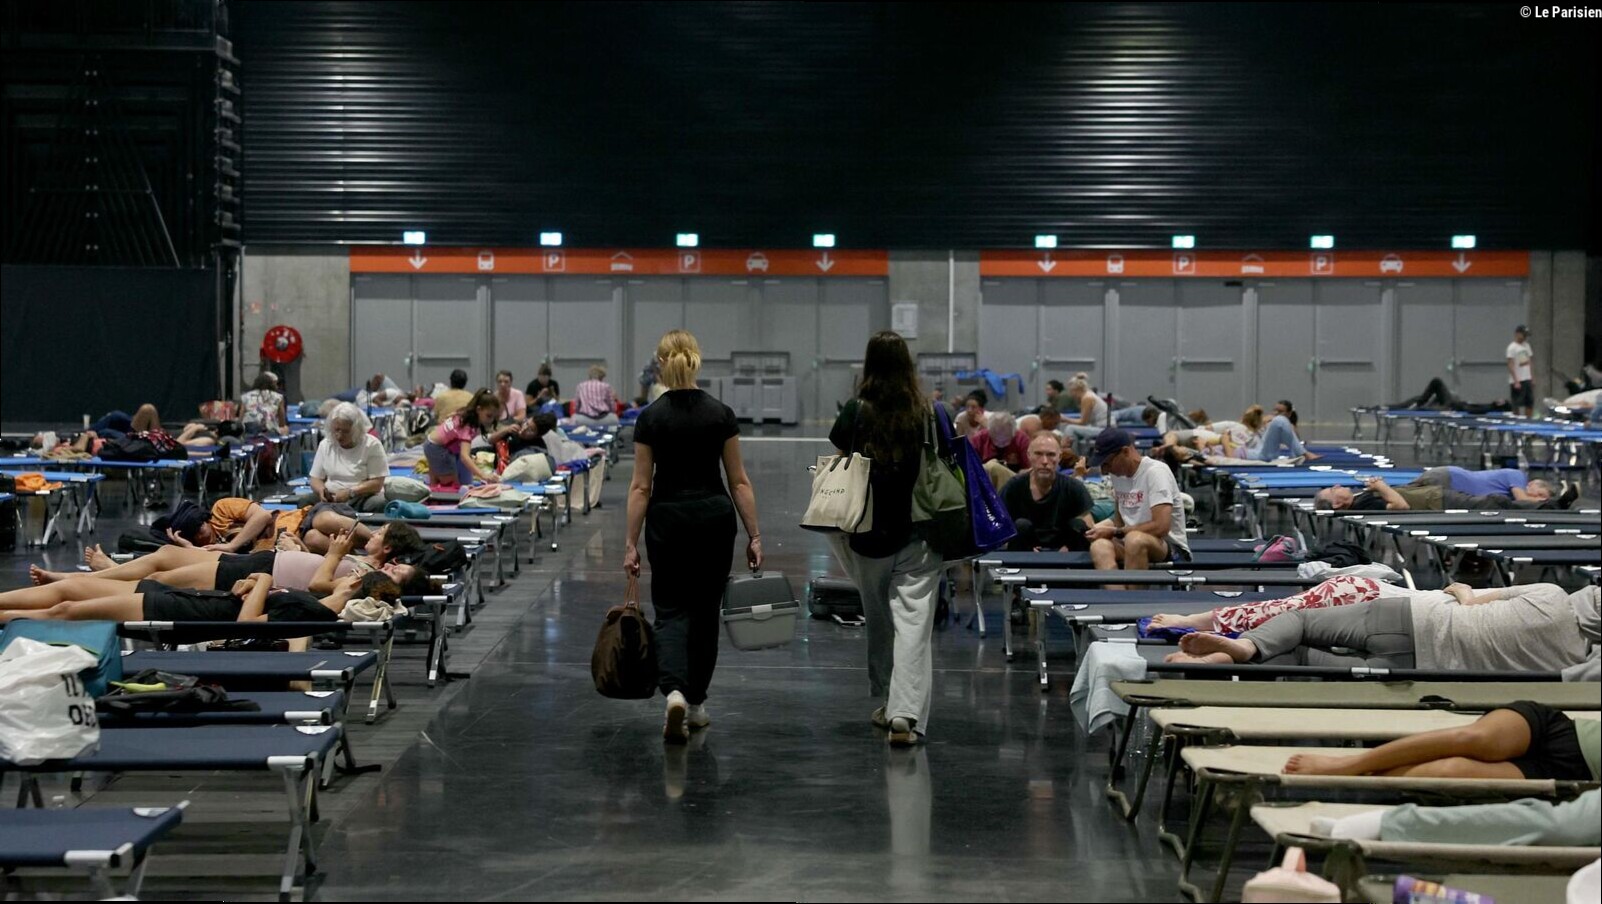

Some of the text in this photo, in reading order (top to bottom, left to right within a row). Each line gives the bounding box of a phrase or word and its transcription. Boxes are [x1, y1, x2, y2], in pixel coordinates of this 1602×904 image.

[549, 253, 560, 268] P
[684, 254, 695, 270] P
[1178, 256, 1190, 271] P
[1316, 256, 1327, 271] P
